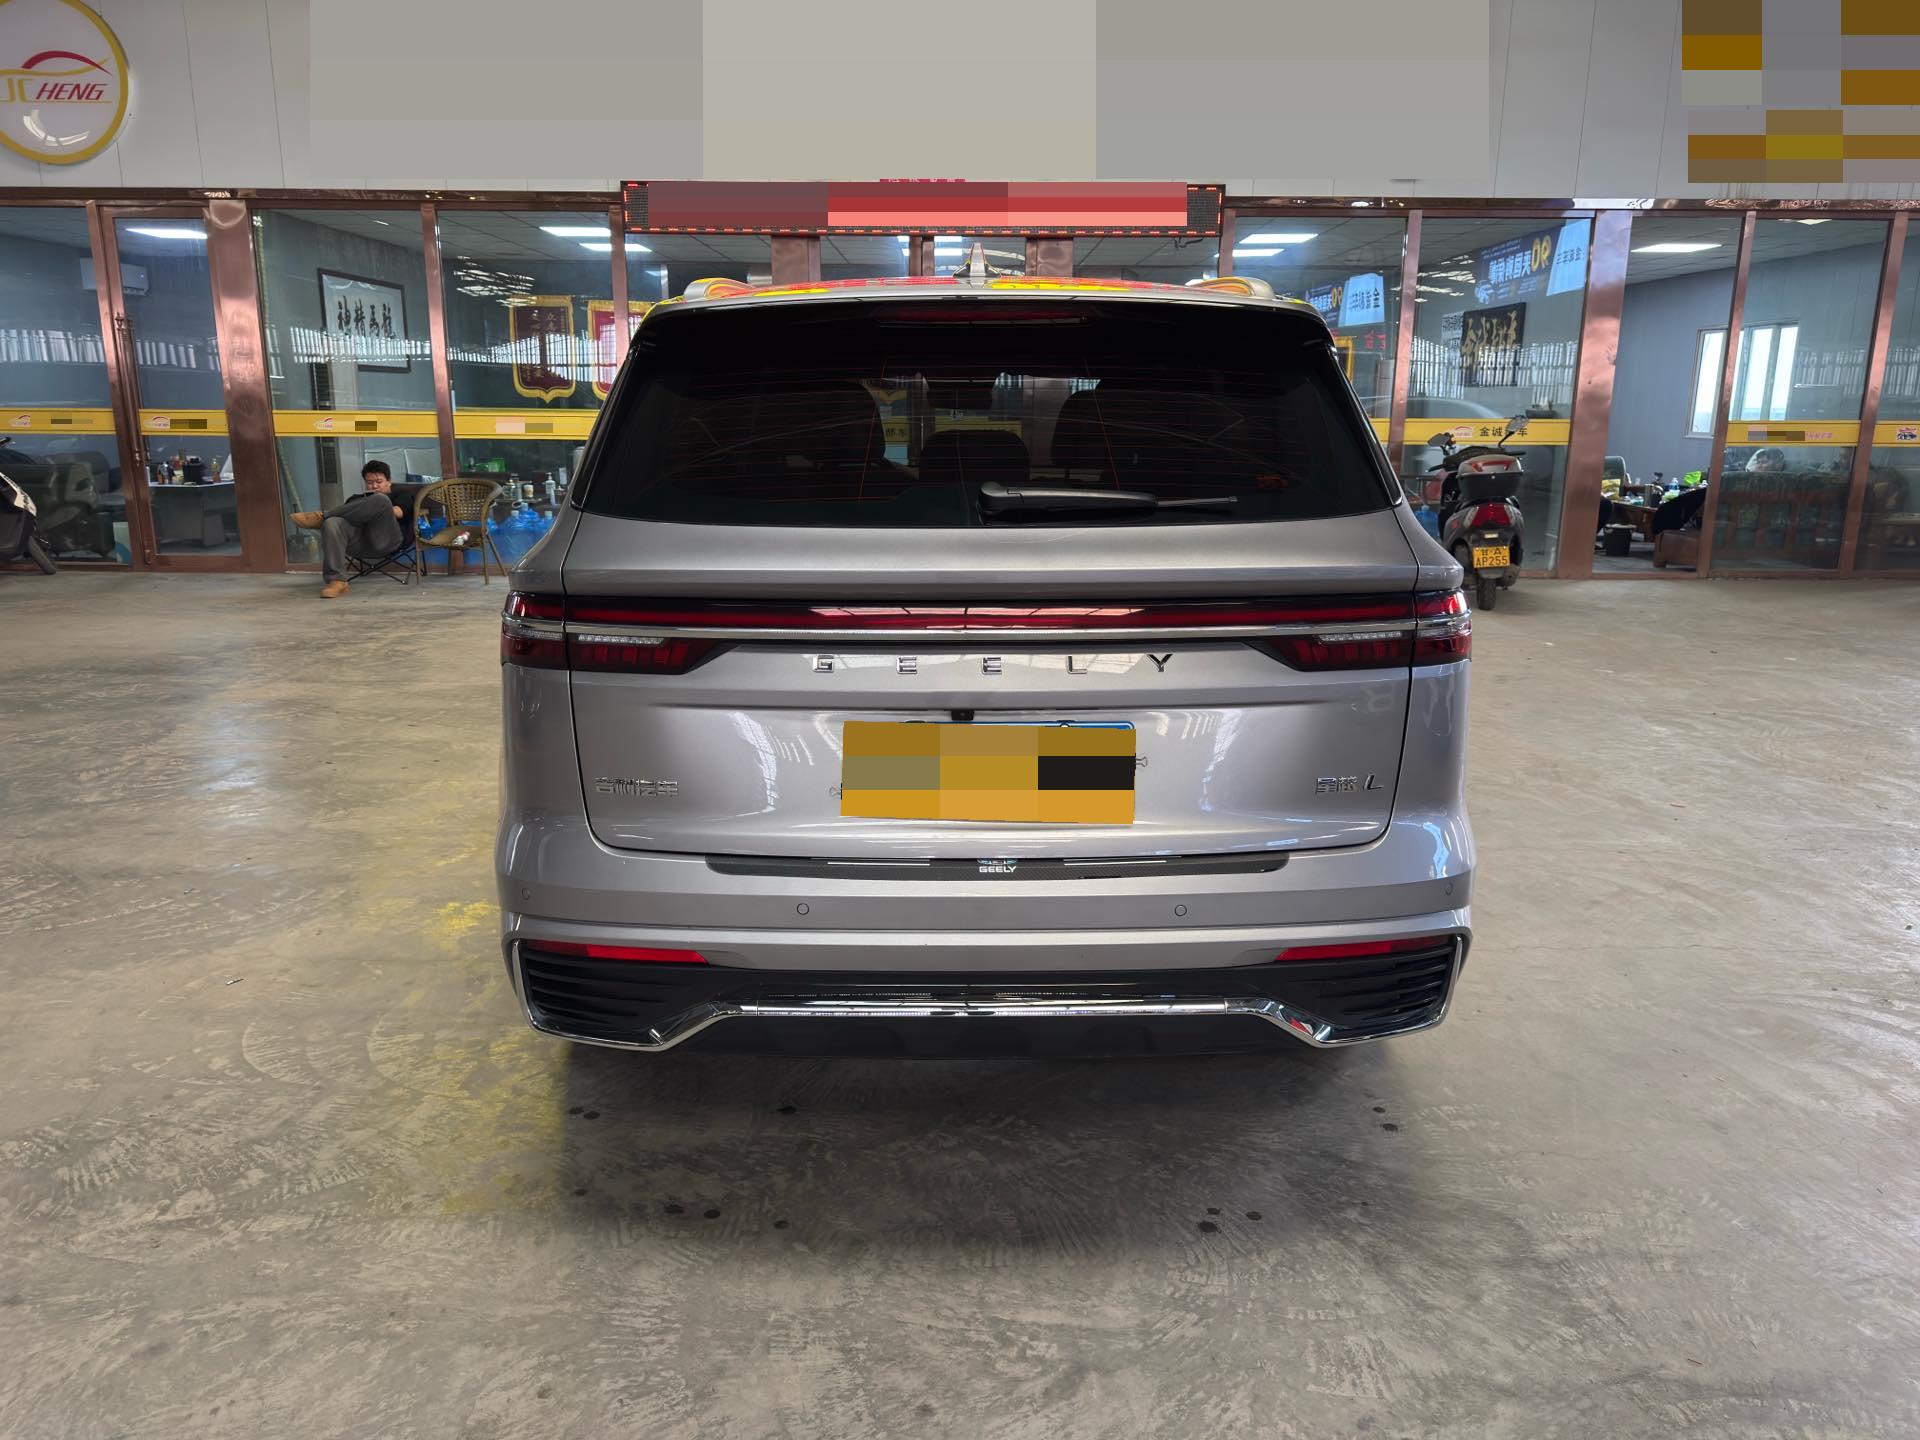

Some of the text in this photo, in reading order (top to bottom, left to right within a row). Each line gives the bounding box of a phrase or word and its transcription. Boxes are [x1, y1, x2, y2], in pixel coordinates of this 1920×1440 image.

[1480, 426, 1528, 438] 金诚车
[812, 652, 1174, 675] GEELY
[1363, 773, 1384, 791] L
[978, 865, 1017, 874] GEELY
